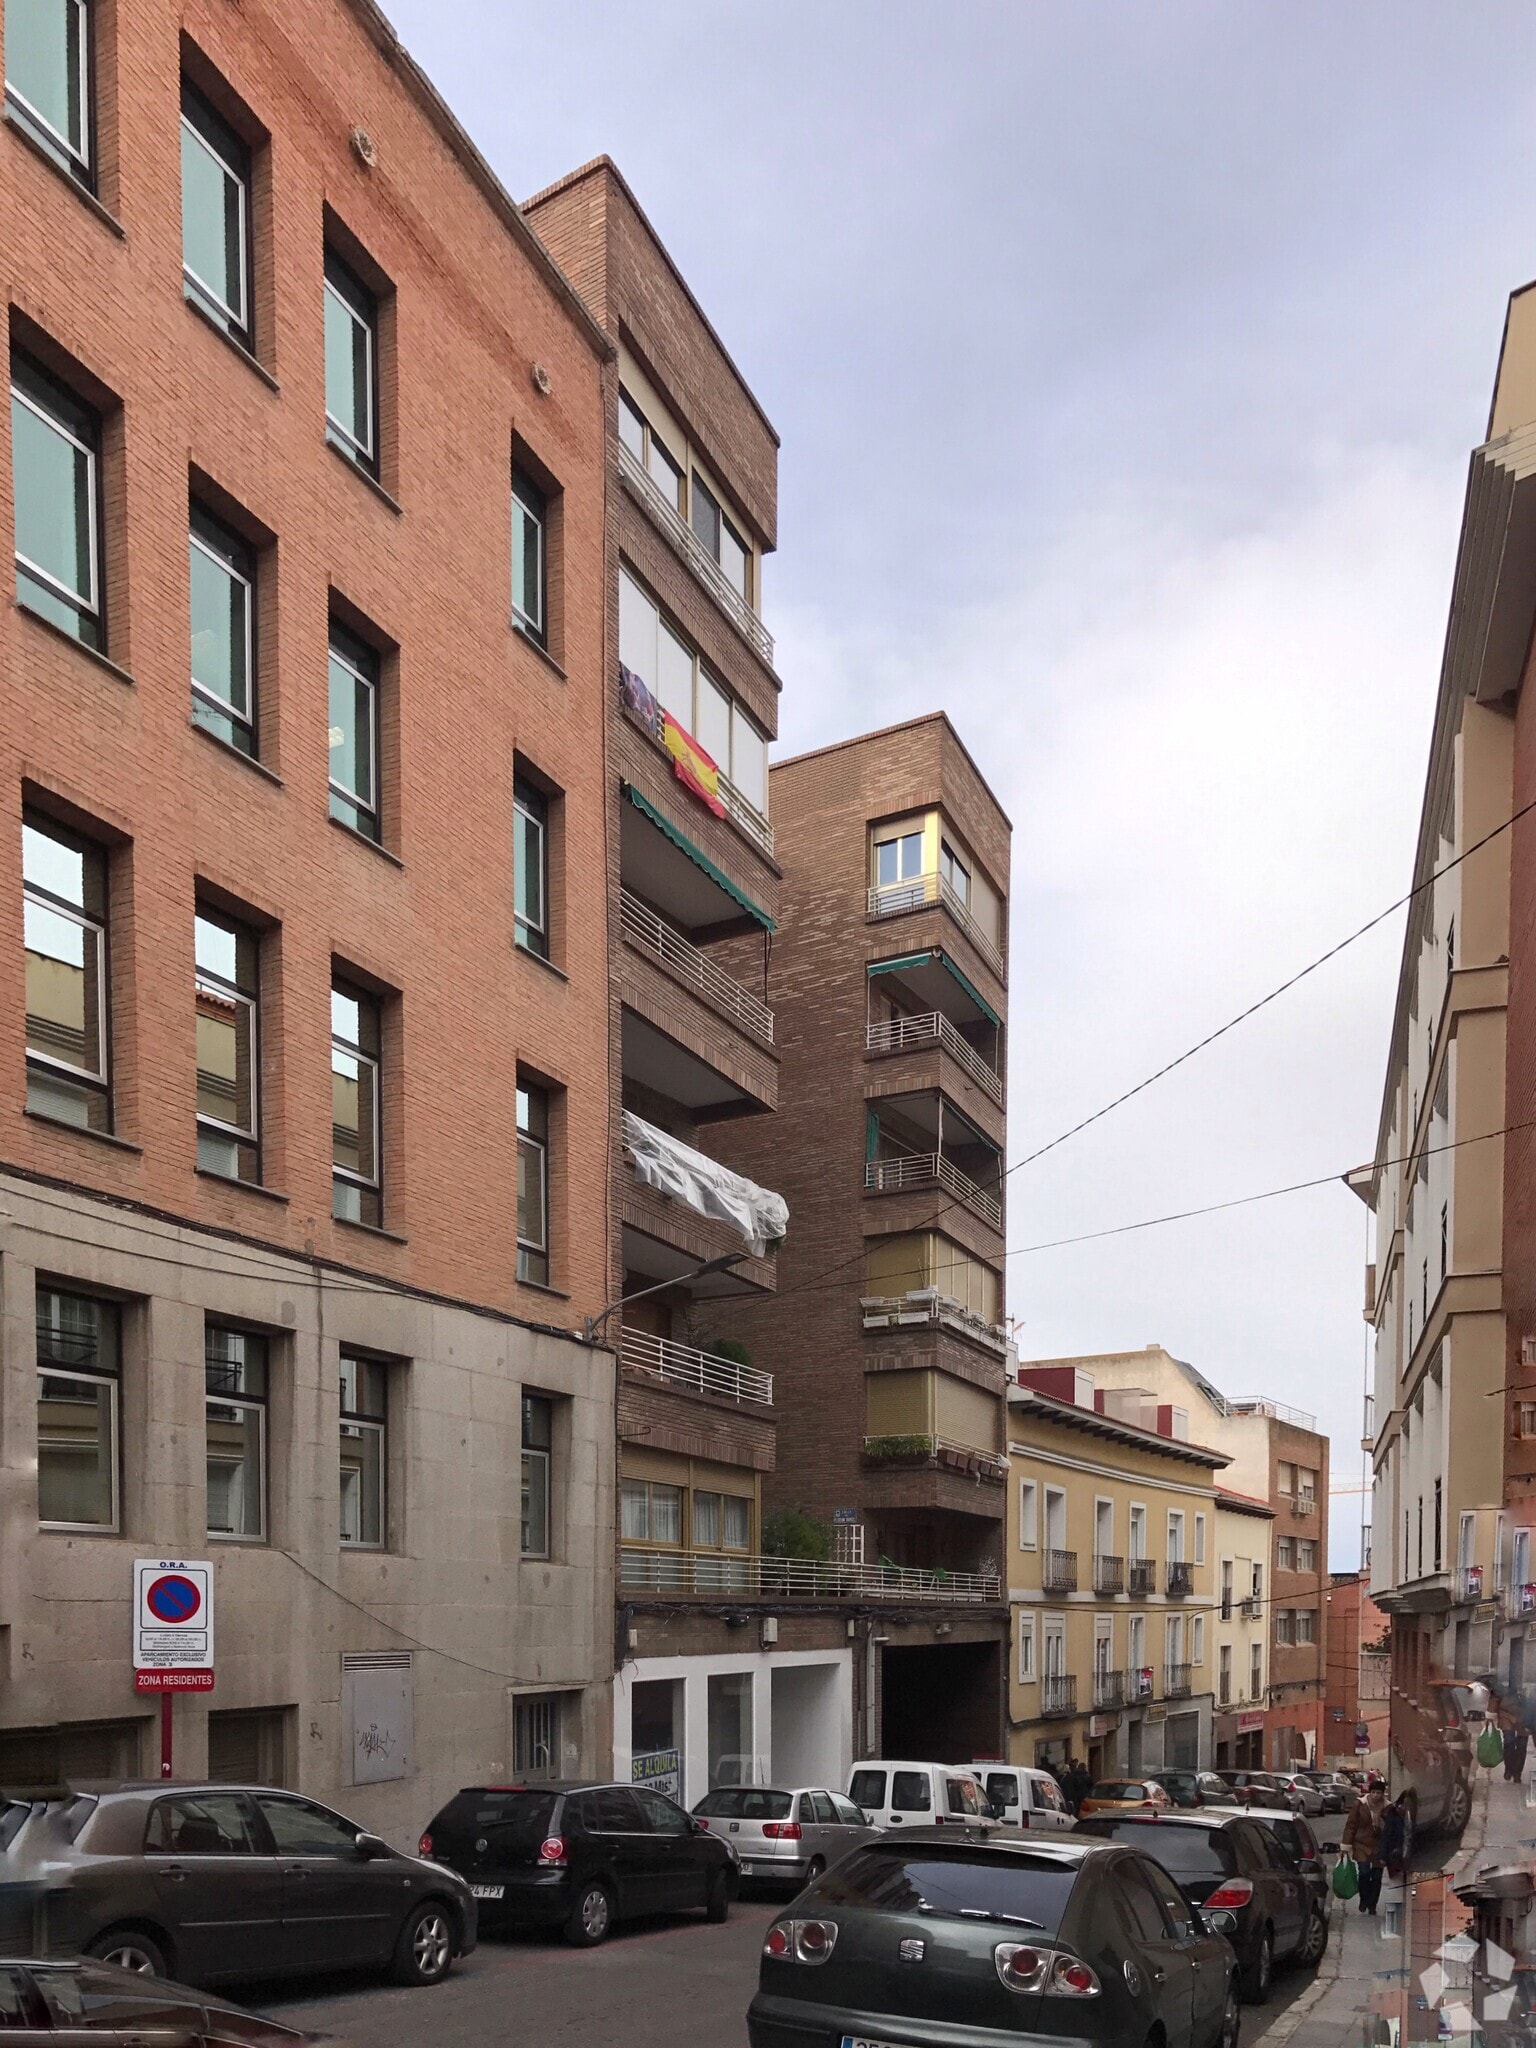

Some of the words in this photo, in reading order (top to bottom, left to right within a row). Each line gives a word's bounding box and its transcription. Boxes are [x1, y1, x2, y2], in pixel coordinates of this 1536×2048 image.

[159, 1561, 188, 1569] O.R.A.
[138, 1675, 161, 1685] ZONA
[162, 1675, 212, 1685] RESIDENTES
[632, 1760, 643, 1780] SE
[645, 1753, 677, 1777] ALQUILA
[482, 1885, 502, 1897] FPX
